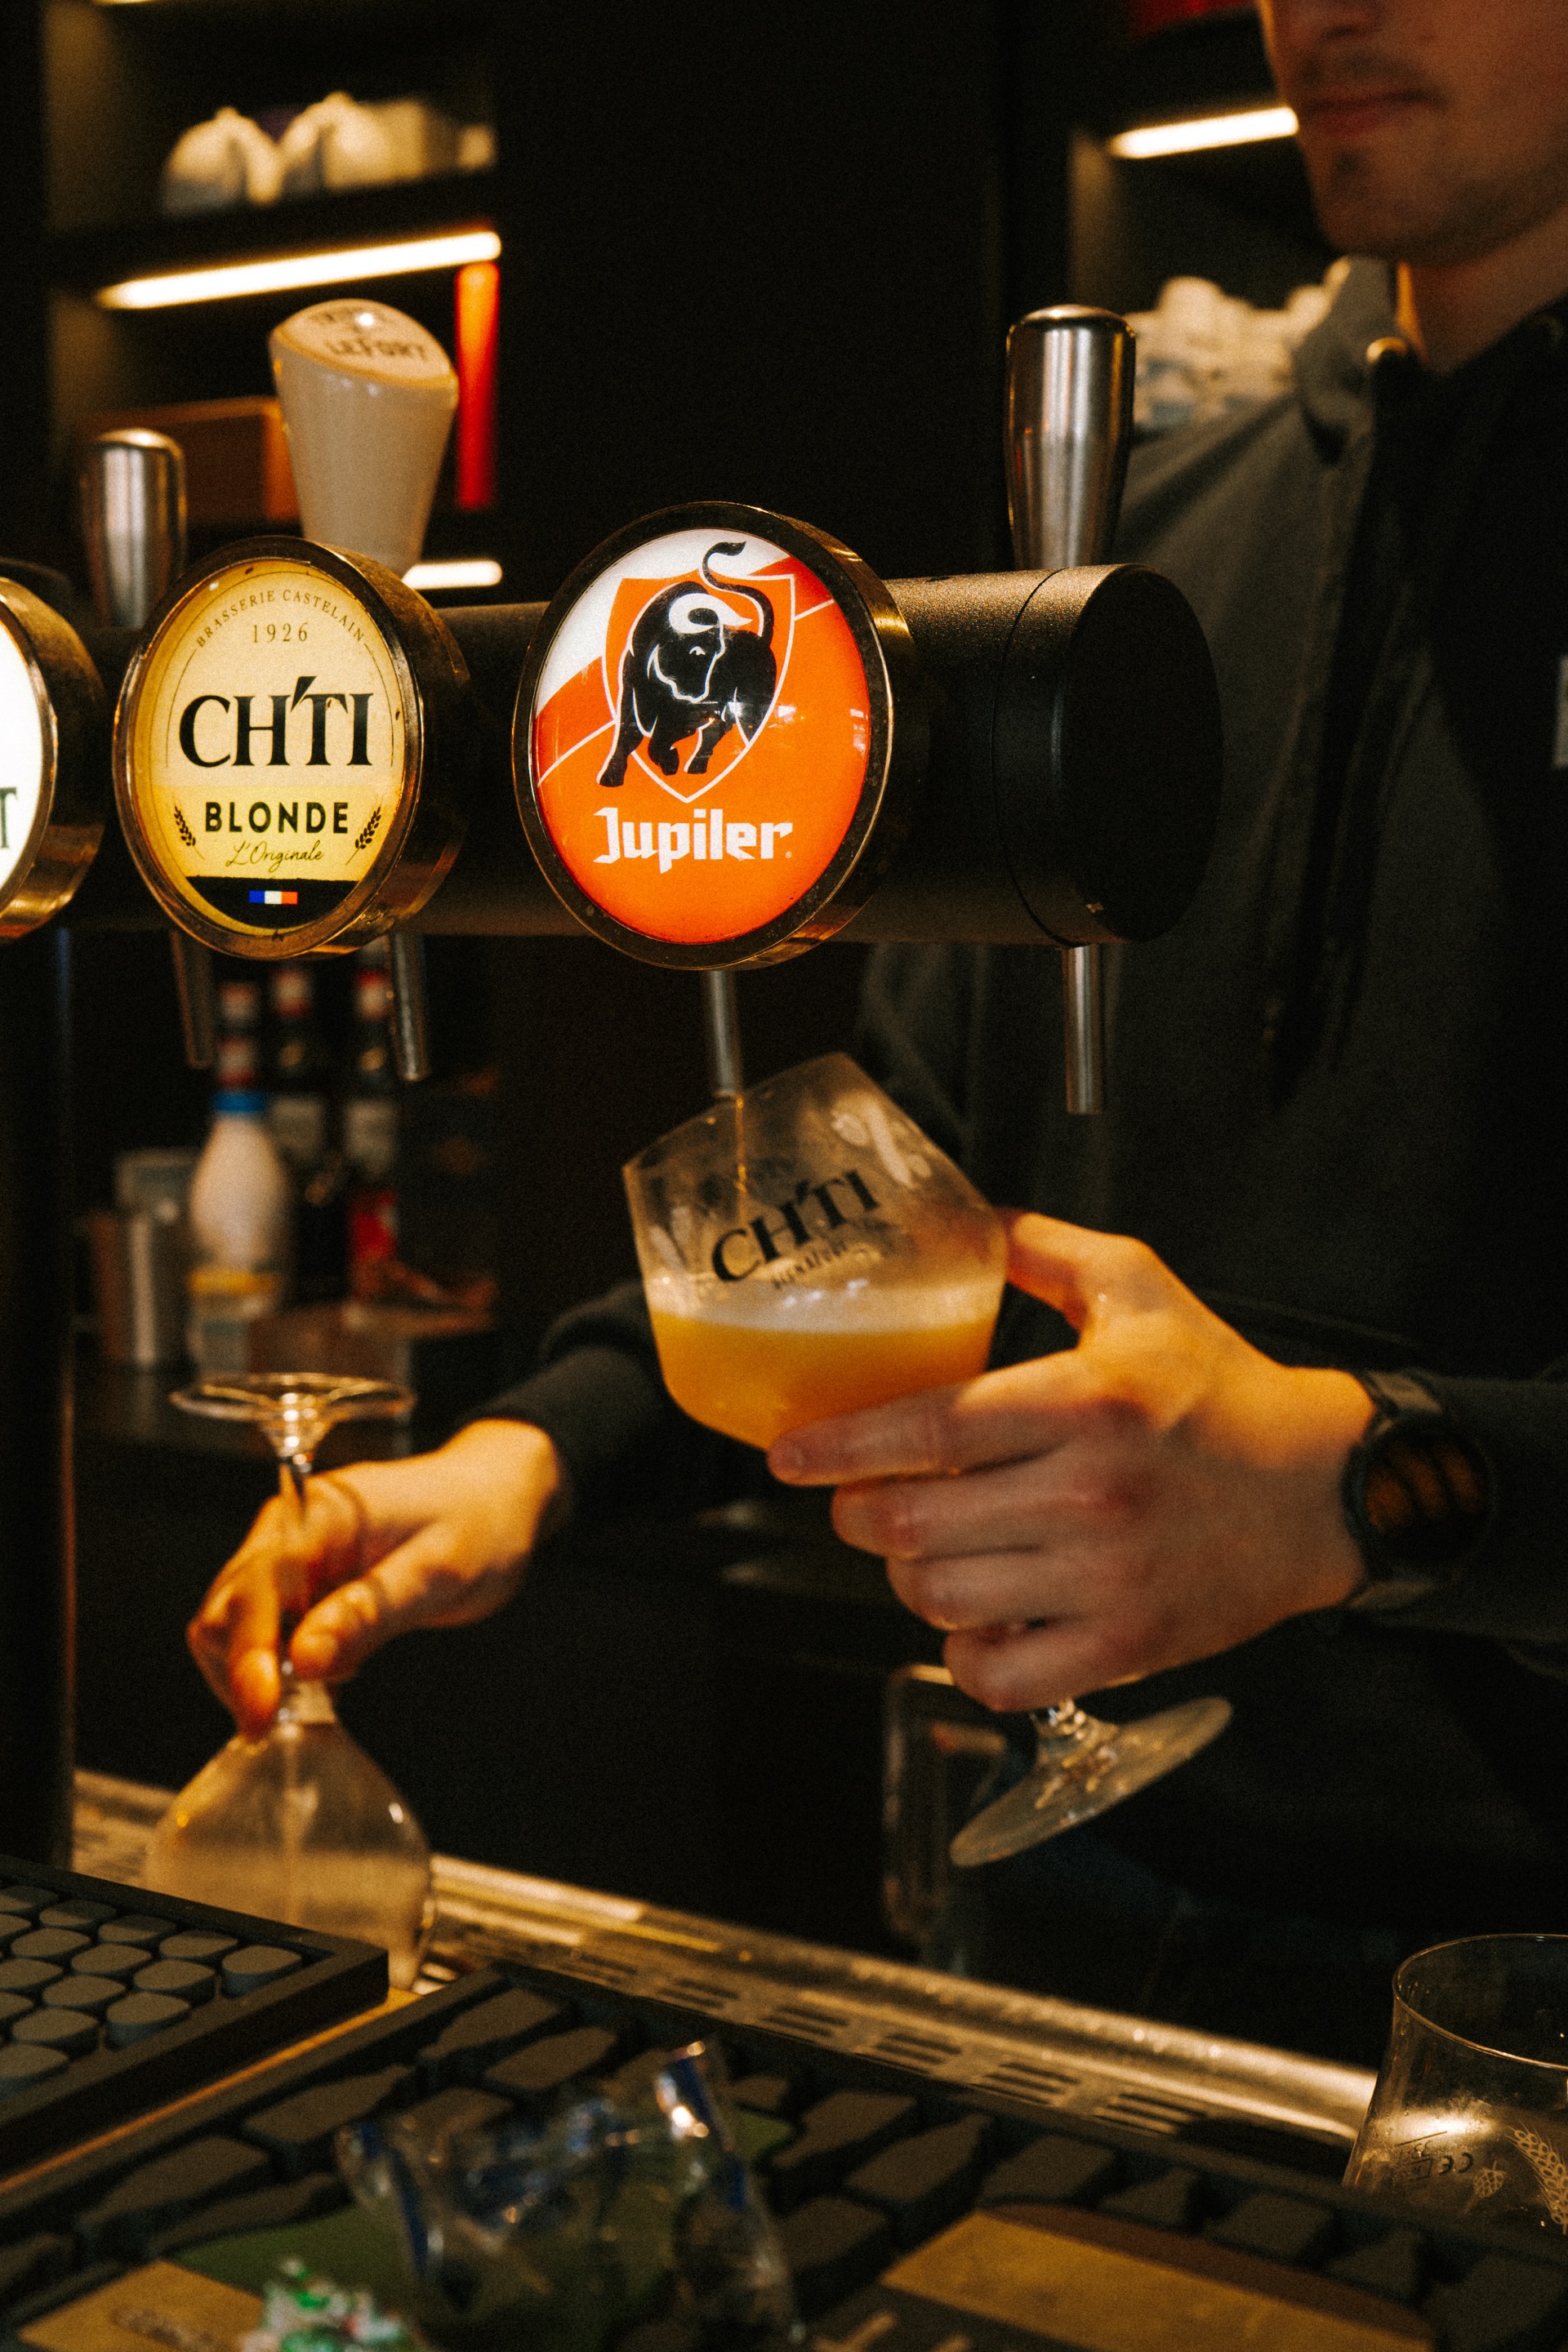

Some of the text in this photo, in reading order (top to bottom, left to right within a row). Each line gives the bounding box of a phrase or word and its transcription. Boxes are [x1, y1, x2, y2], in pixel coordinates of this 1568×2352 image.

[195, 589, 365, 648] BRASSERIE CASTELAIN
[252, 621, 309, 644] 1926
[204, 801, 349, 834] BLONDE
[225, 839, 324, 873] L'Originale
[593, 807, 793, 874] Jupiler
